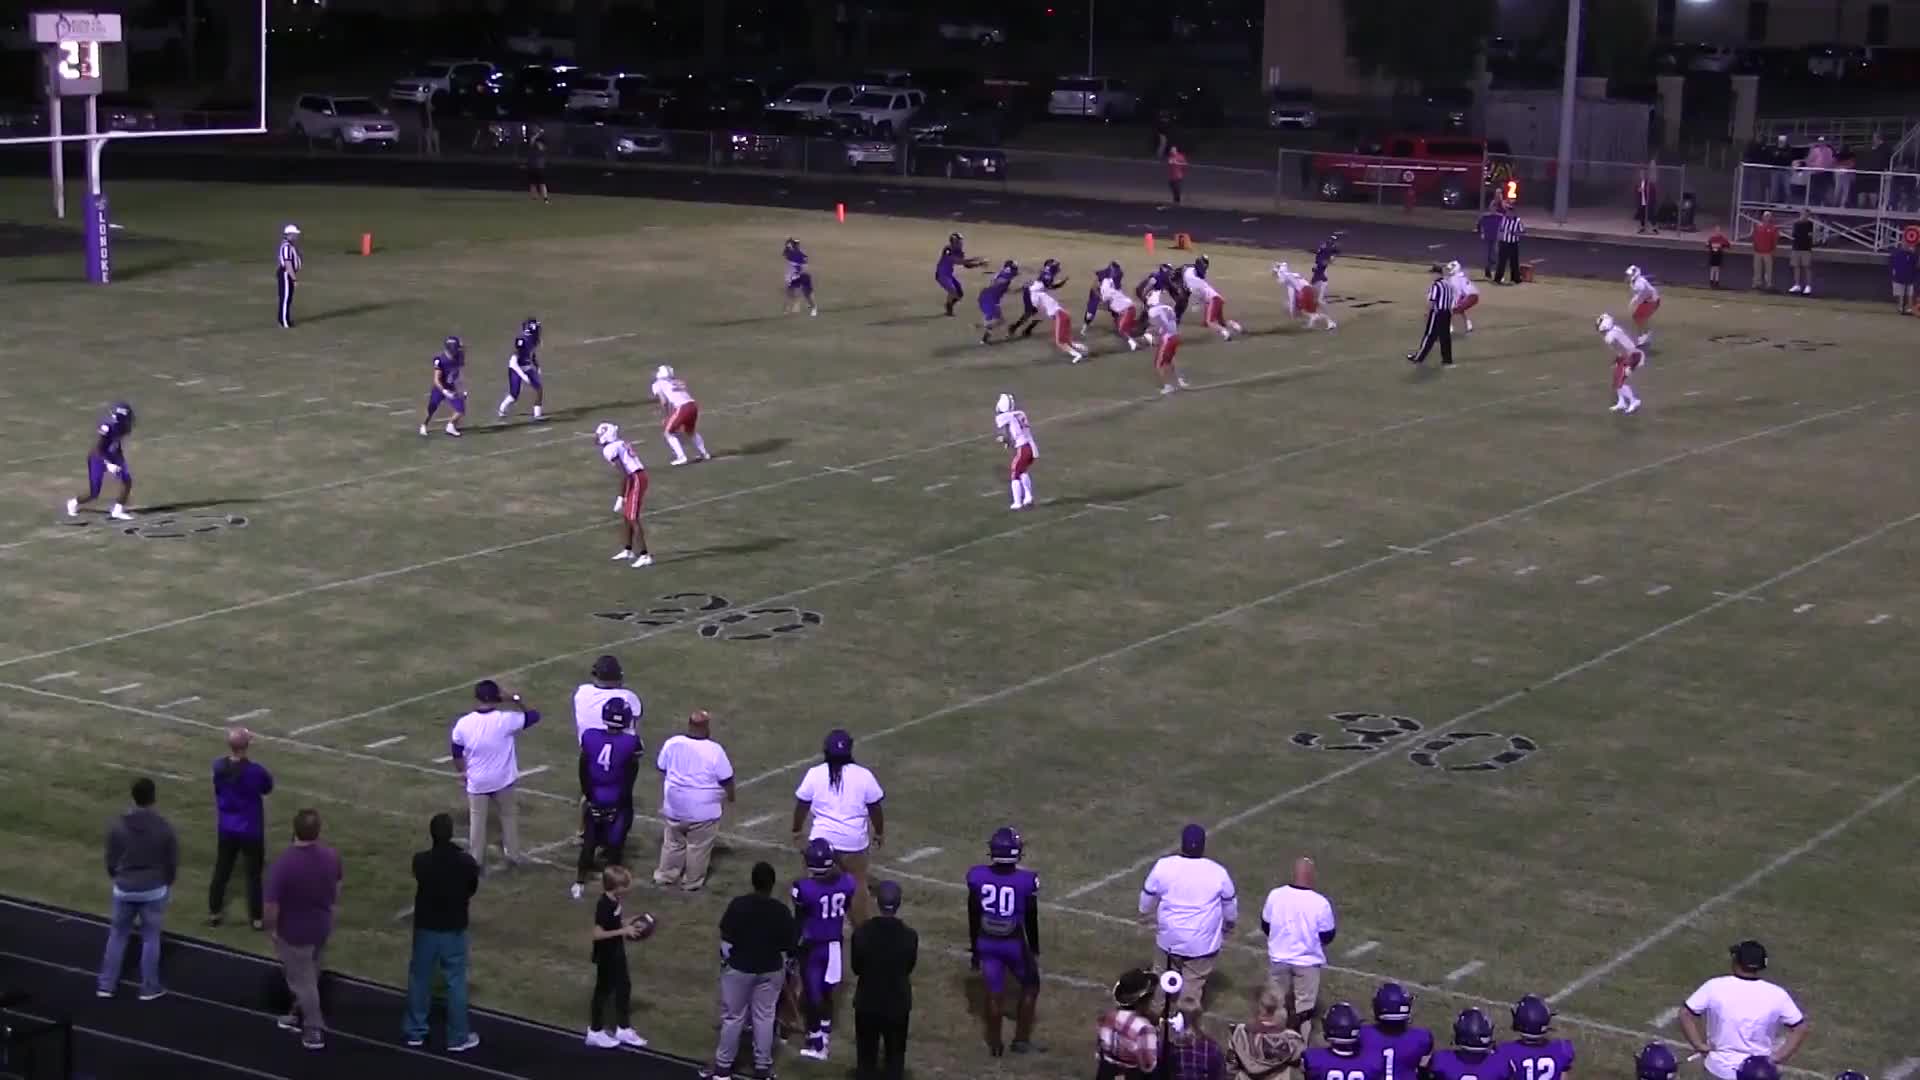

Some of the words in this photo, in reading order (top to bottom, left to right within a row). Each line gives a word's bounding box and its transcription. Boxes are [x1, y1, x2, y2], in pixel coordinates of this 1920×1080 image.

[59, 40, 100, 79] 21
[1507, 181, 1517, 199] 2
[597, 743, 613, 772] 4
[980, 883, 1016, 917] 20
[1383, 1048, 1395, 1080] 1
